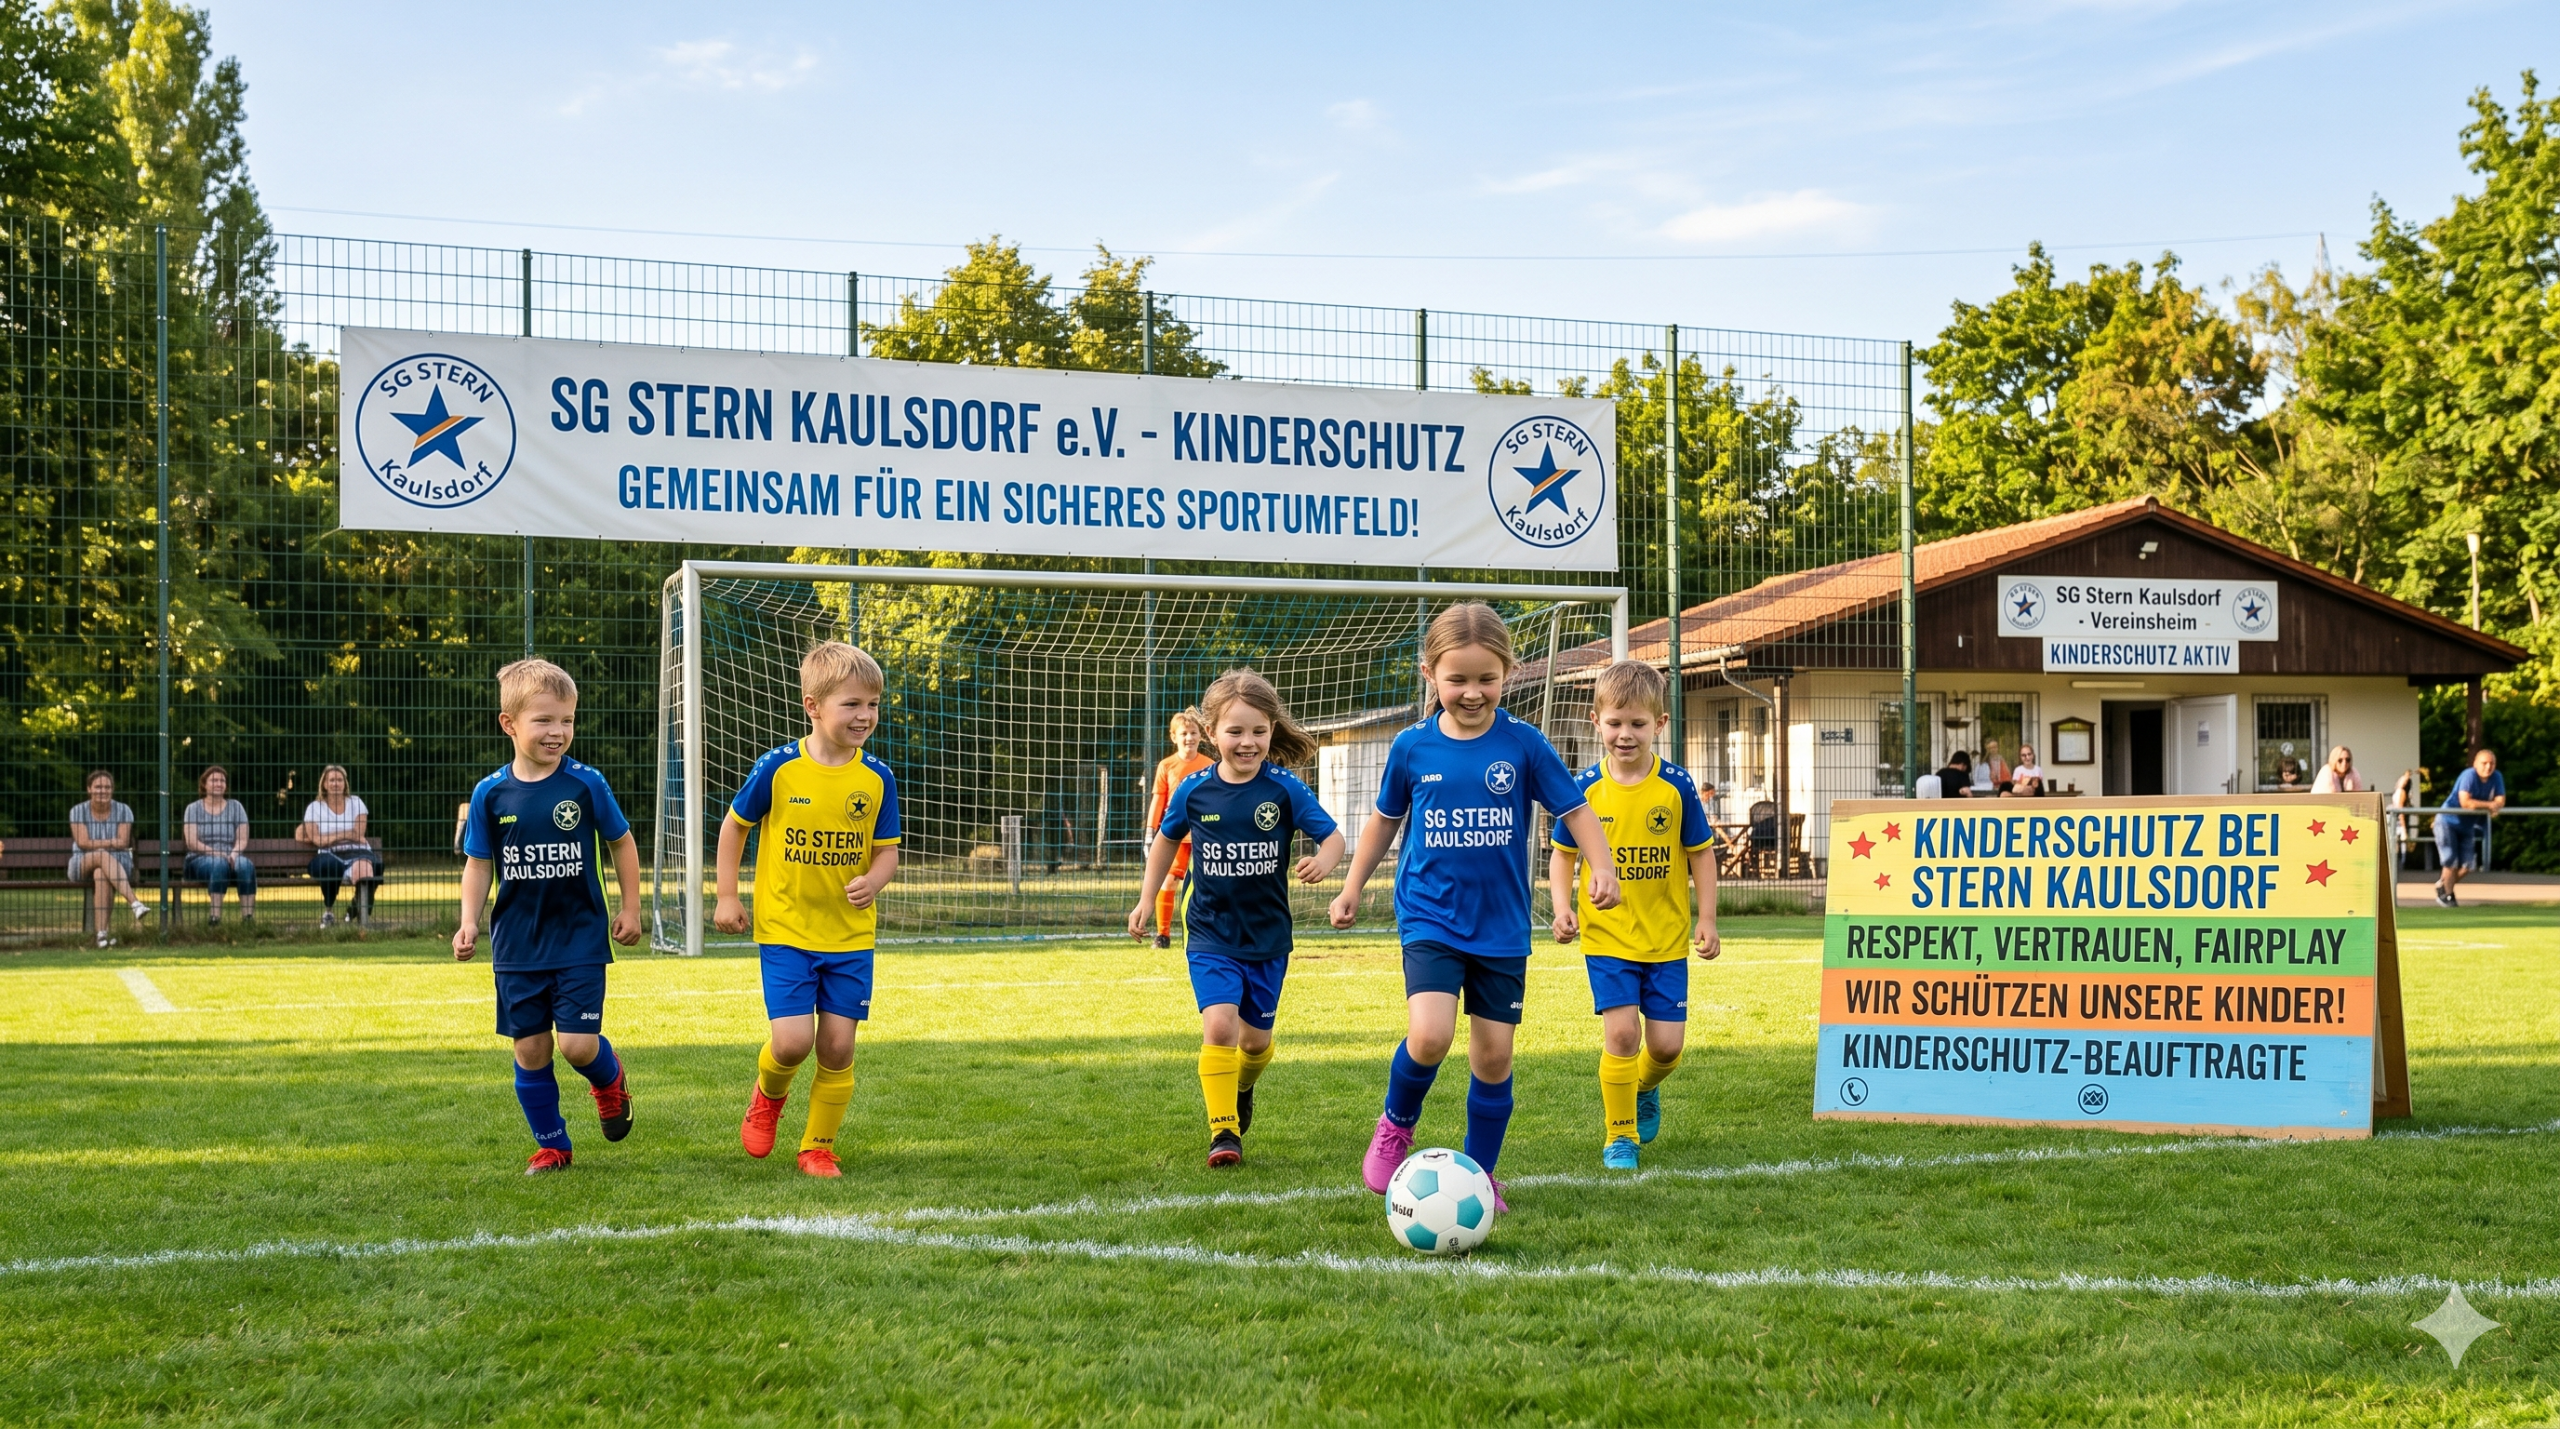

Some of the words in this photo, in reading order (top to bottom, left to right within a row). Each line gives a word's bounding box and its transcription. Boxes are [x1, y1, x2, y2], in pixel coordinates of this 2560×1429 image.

[380, 369, 413, 398] SG
[417, 362, 495, 403] STERN
[550, 376, 610, 434] SG
[628, 380, 772, 441] STERN
[791, 390, 1040, 454] KAULSDORF
[1056, 406, 1125, 458] e.V.
[1173, 411, 1466, 473] KINDERSCHUTZ
[1505, 429, 1529, 454] SG
[1532, 423, 1588, 457] STERN
[379, 458, 493, 500] Kaulsdorf
[618, 464, 839, 517] GEMEINSAM
[854, 466, 922, 520] FÜR
[935, 478, 990, 523] EIN
[1003, 481, 1166, 529] SICHERES
[1177, 488, 1419, 538] SPORTUMFELD!
[1505, 505, 1588, 541] Kaulsdorf
[2056, 585, 2080, 604] SG
[2086, 586, 2133, 605] Stern
[2139, 588, 2221, 606] Kaulsdorf
[2090, 611, 2197, 630] Vereinsheim
[2051, 643, 2178, 666] KINDERSCHUTZ
[2183, 645, 2231, 666] AKTIV
[1424, 808, 1447, 828] SG
[1452, 807, 1513, 828] STERN
[784, 827, 807, 847] SG
[811, 830, 864, 849] STERN
[1425, 829, 1513, 848] KAULSDORF
[1914, 814, 2204, 859] KINDERSCHUTZ
[2218, 813, 2279, 857] BEI
[503, 845, 520, 864] SG
[524, 841, 582, 862] STERN
[784, 847, 863, 866] KAULSDORF
[1202, 842, 1222, 860] SG
[1226, 841, 1279, 860] STERN
[1616, 846, 1671, 864] STERN
[503, 861, 583, 881] KAULSDORF
[1203, 859, 1279, 877] KAULSDORF
[1615, 865, 1671, 881] LSDORF
[1911, 865, 2032, 909] STERN
[2046, 864, 2280, 910] KAULSDORF
[1846, 925, 1982, 966] RESPEKT,
[1993, 926, 2182, 969] VERTRAUEN,
[2194, 927, 2347, 965] FAIRPLAY
[1845, 979, 1901, 1015] WIR
[1911, 973, 2068, 1018] SCHÜTZEN
[2080, 984, 2203, 1021] UNSERE
[2214, 986, 2345, 1024] KINDER!
[1842, 1033, 2307, 1082] KINDERSCHUTZ-BEAUFTRAGTE
